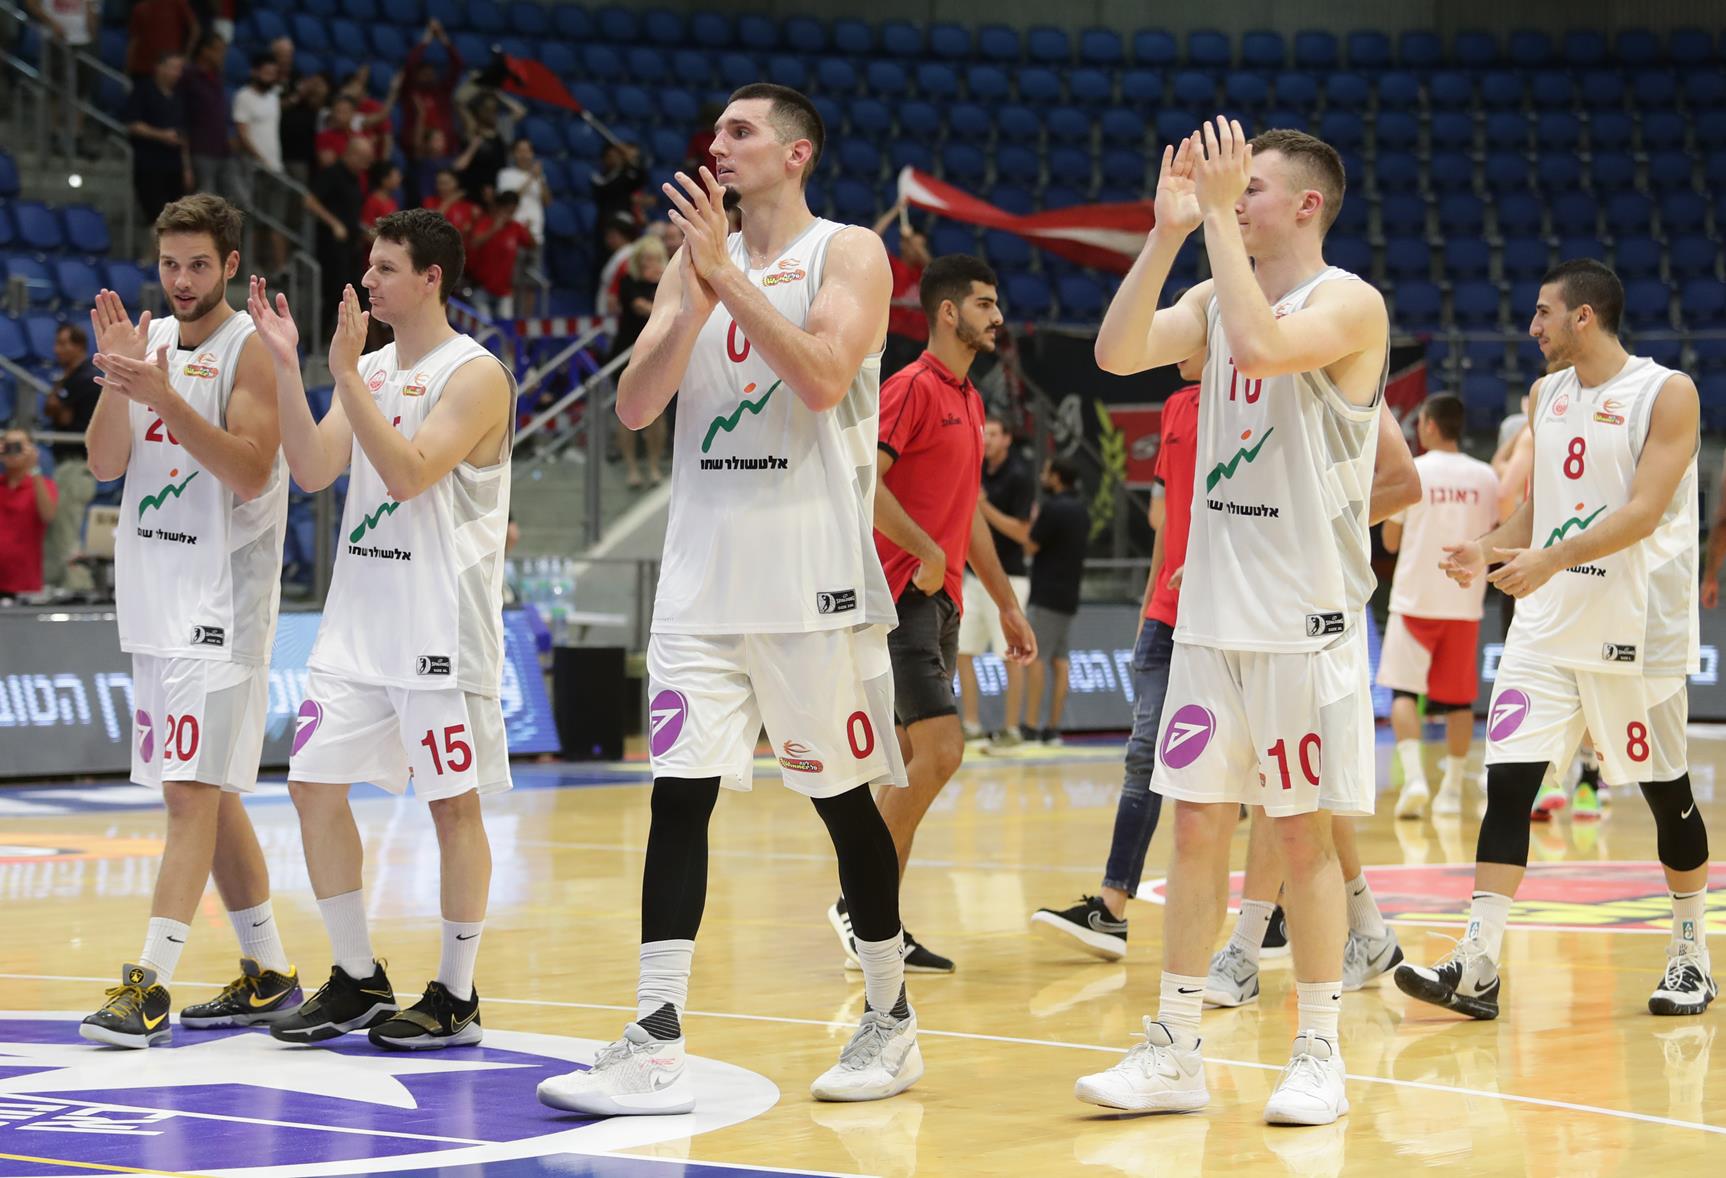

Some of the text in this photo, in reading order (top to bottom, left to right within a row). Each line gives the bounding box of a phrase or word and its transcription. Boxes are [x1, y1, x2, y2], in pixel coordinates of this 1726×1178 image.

[724, 456, 788, 470] אלטשולר
[1563, 436, 1586, 480] 8
[1430, 487, 1479, 505] ראובן
[163, 714, 199, 762] 20
[421, 723, 472, 776] 15
[846, 710, 875, 760] 0
[1626, 721, 1650, 762] 8
[1267, 732, 1321, 790] 10
